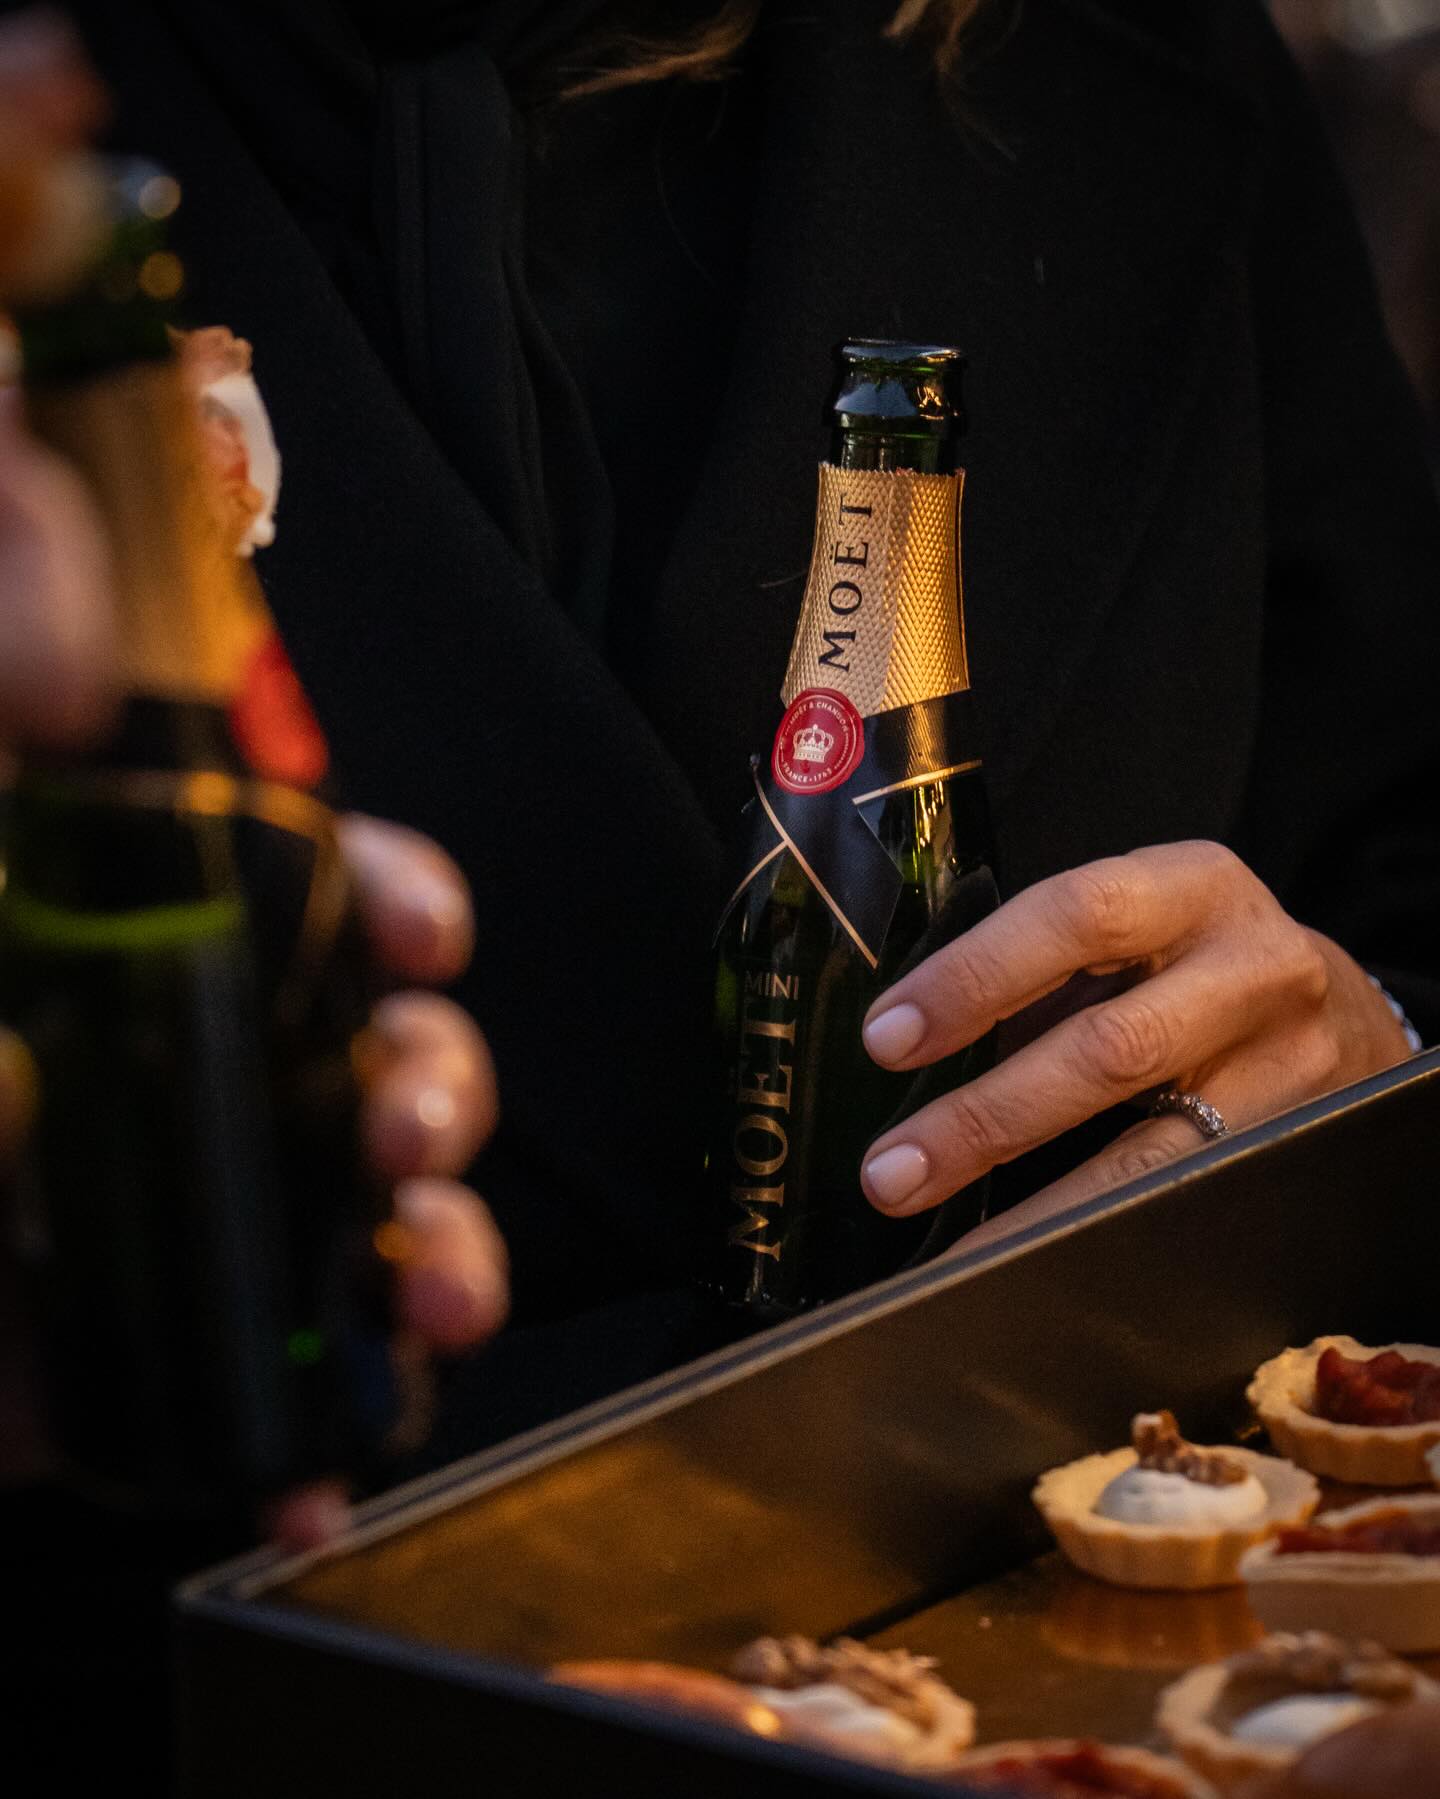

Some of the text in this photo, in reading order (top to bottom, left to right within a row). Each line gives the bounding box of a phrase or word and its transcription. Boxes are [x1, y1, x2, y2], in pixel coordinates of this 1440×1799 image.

[819, 494, 872, 672] MOËT
[816, 700, 850, 733] CHANDON
[742, 968, 800, 1001] MINI
